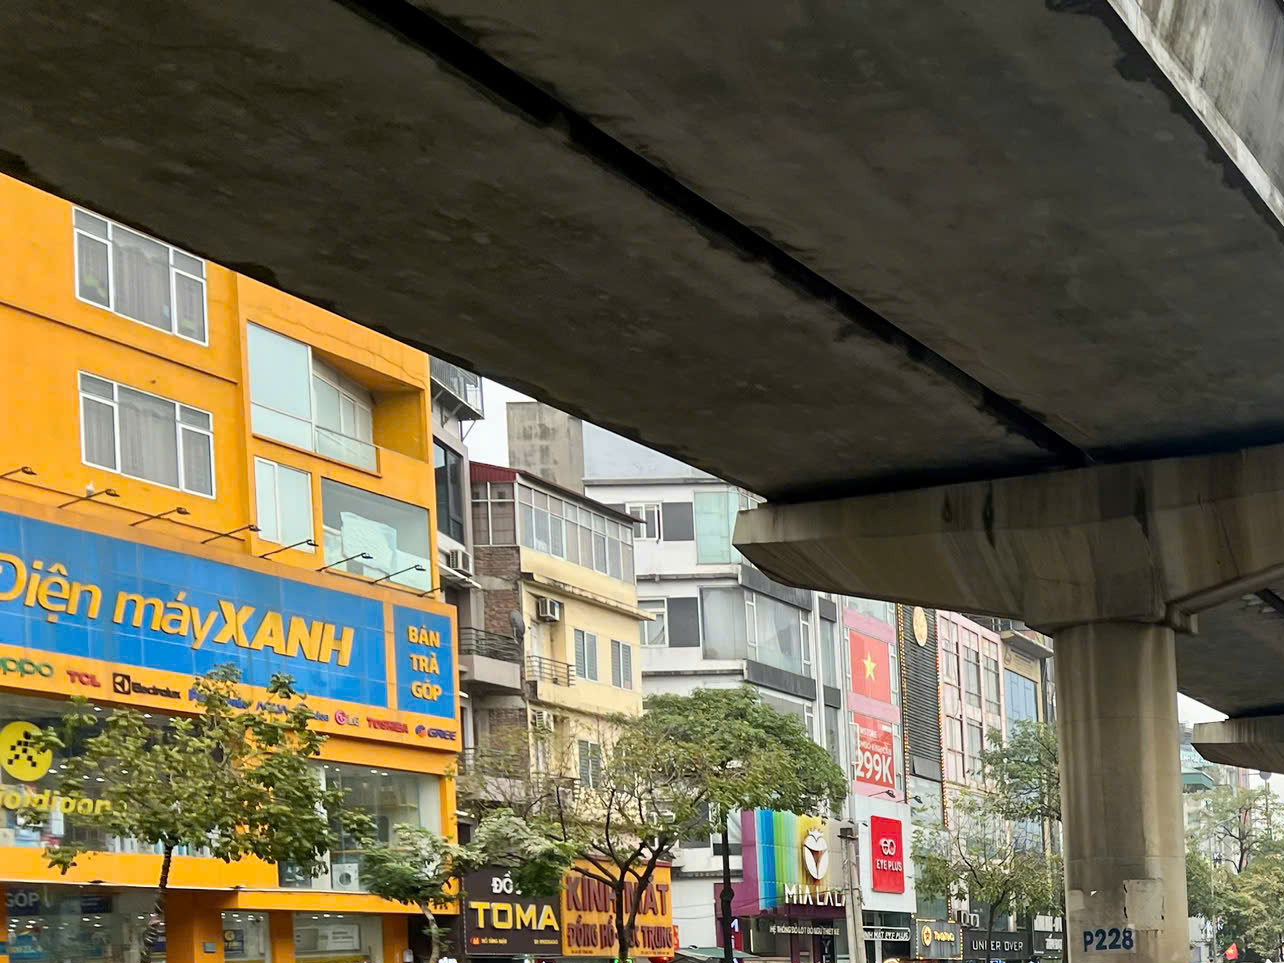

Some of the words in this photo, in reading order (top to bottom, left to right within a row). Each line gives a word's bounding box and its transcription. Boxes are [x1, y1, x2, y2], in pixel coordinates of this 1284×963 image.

[212, 599, 355, 668] XANH
[0, 656, 54, 678] ppo
[66, 670, 101, 688] TCL
[427, 727, 457, 741] GREE
[410, 679, 442, 702] GÓP
[876, 859, 888, 870] EYE
[888, 860, 903, 872] PLUS
[784, 883, 814, 906] MIA
[468, 901, 560, 932] TOMA
[972, 939, 1001, 951] UNER
[1083, 927, 1134, 953] P228
